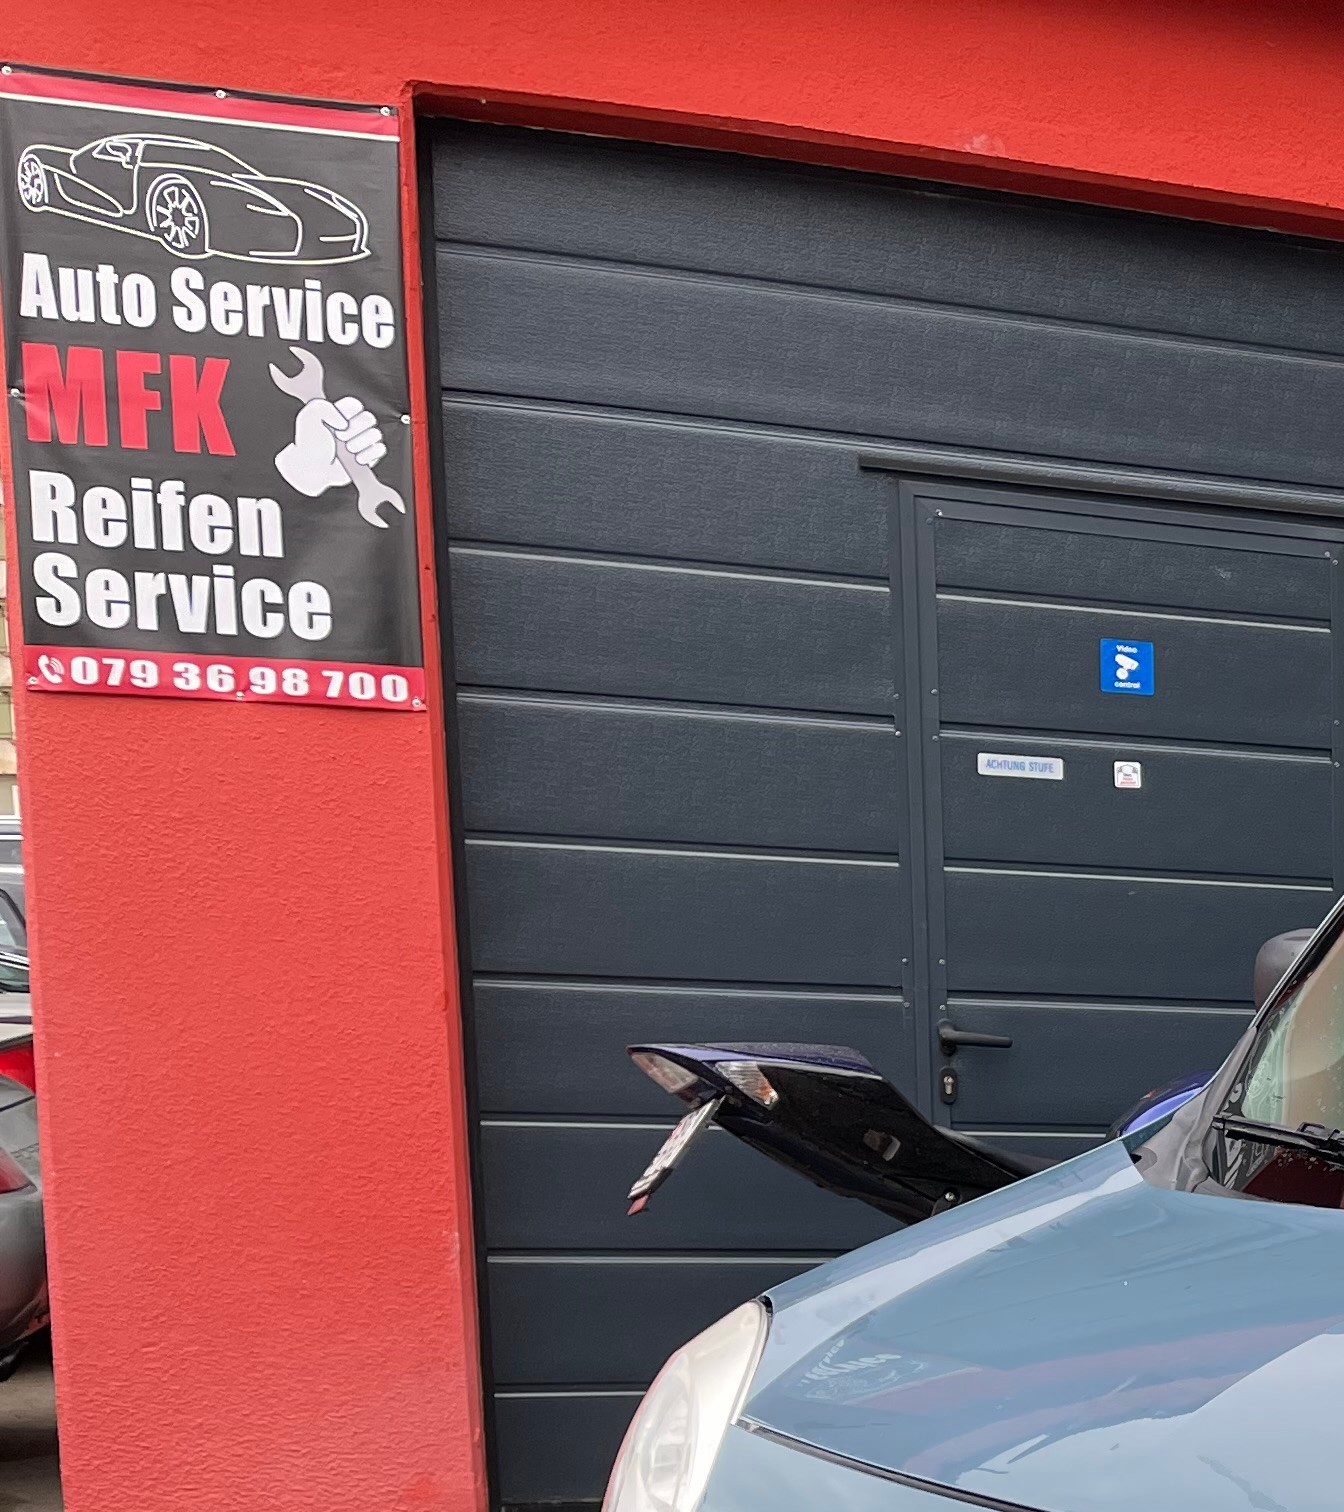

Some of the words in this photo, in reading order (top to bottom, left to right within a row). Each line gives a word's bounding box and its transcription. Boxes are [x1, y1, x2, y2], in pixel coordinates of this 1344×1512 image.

[19, 252, 157, 329] Auto
[170, 265, 396, 349] Service
[21, 342, 237, 456] MFK
[28, 469, 285, 559] Reifen
[32, 552, 333, 642] Service
[71, 656, 164, 690] 079
[172, 660, 236, 693] 36
[249, 665, 310, 697] 98
[321, 669, 410, 703] 700
[985, 758, 1026, 771] ACHTUNG
[1028, 761, 1055, 774] STUFE
